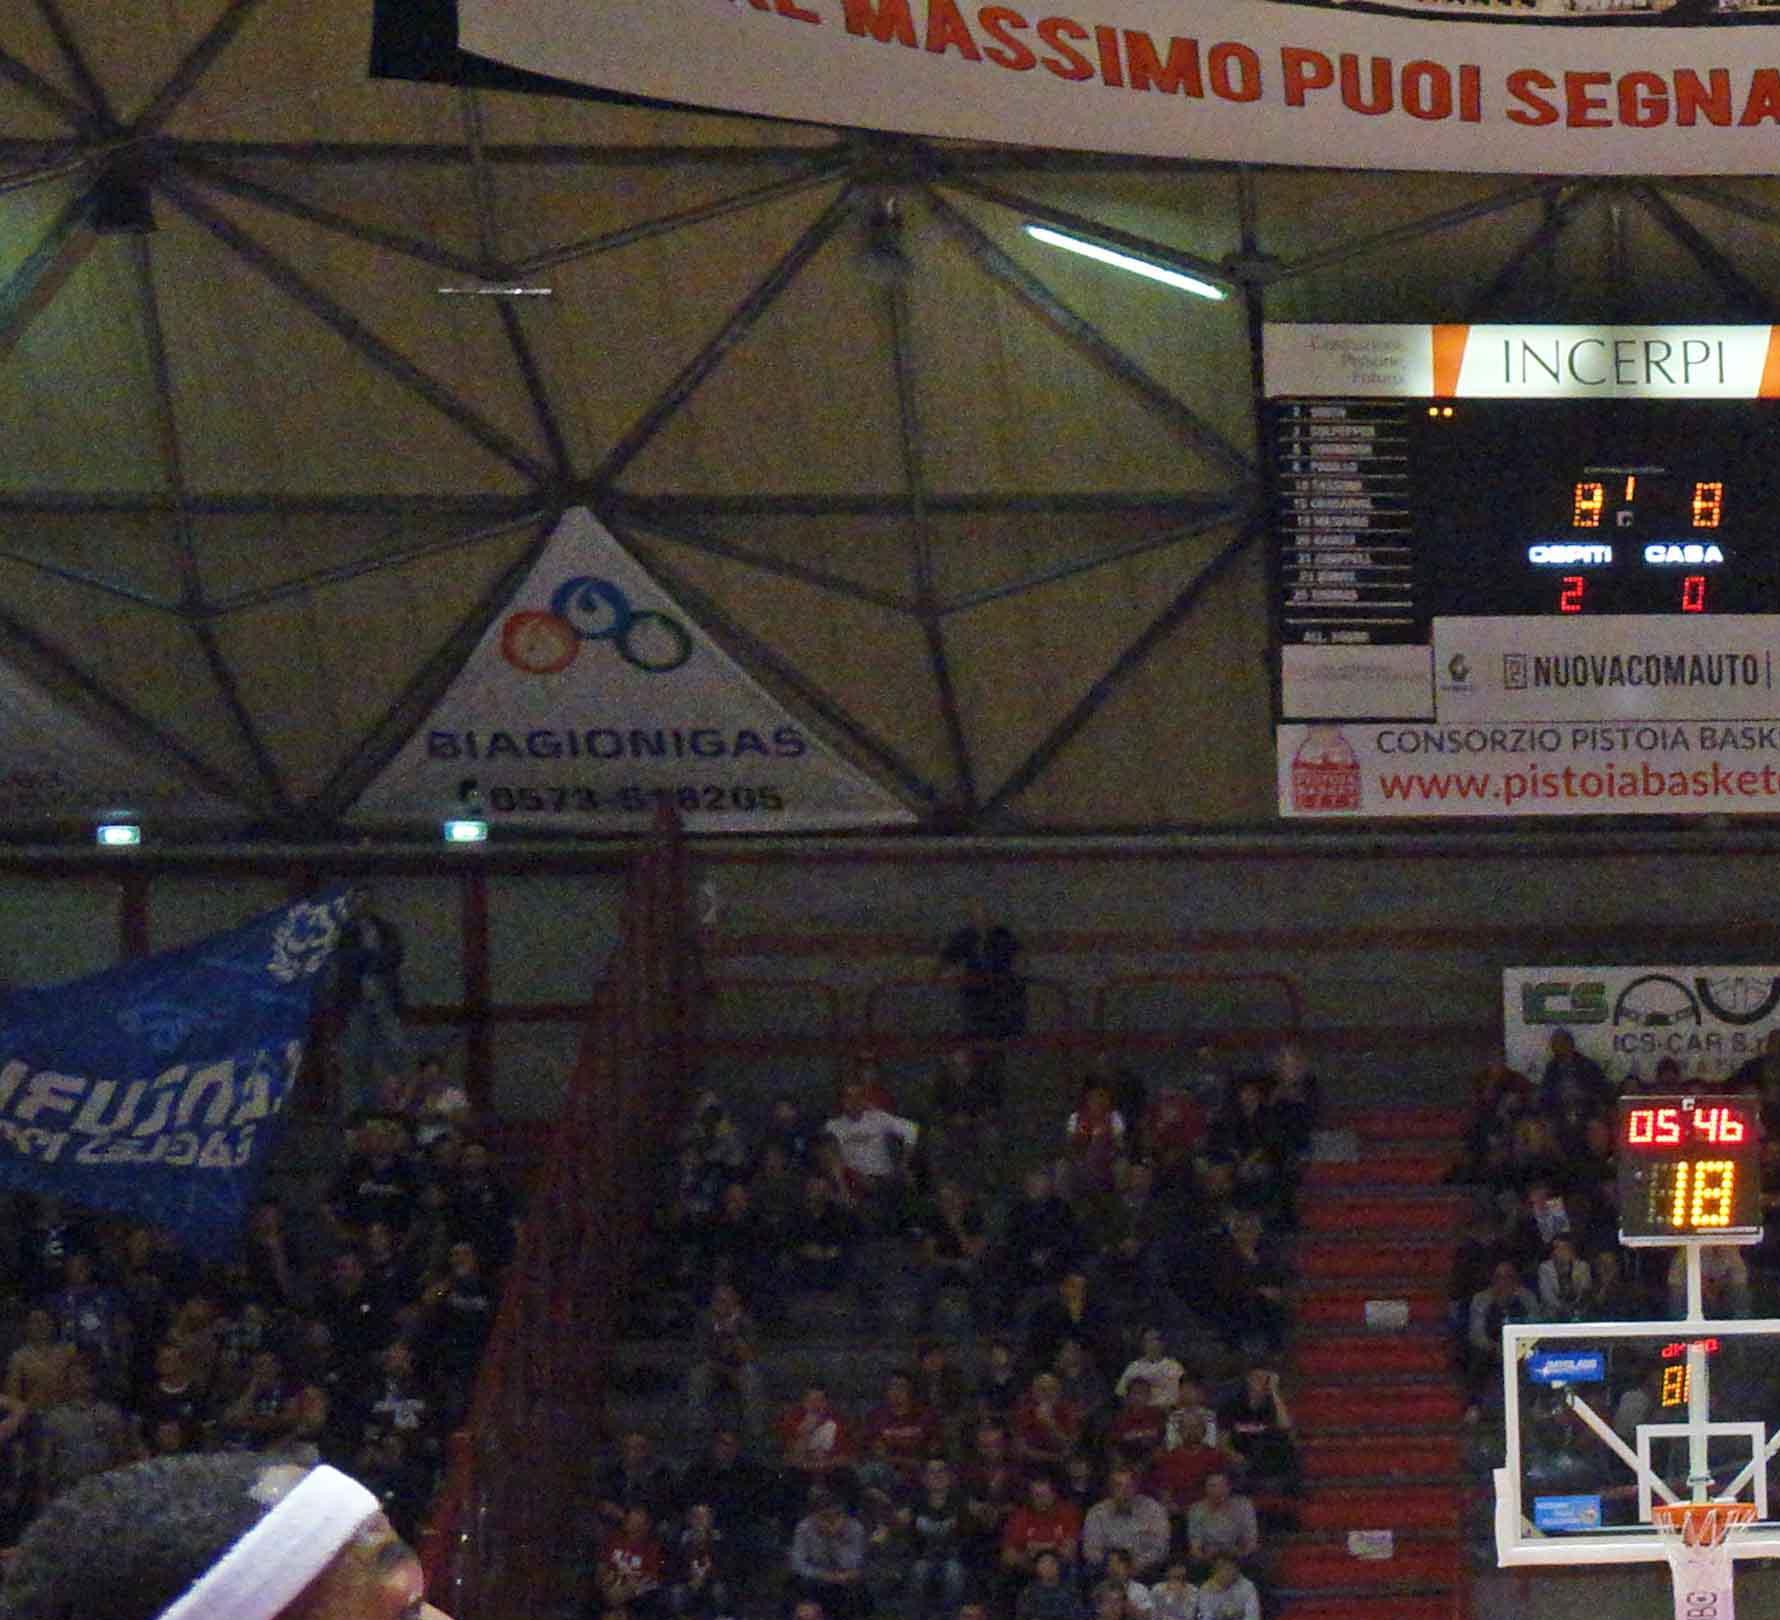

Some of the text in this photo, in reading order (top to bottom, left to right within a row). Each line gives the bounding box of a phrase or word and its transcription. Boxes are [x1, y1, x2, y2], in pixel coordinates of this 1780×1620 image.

[845, 0, 1262, 103] MASSIMO
[1281, 46, 1482, 123] PUOI
[1503, 338, 1725, 386] INCERPI
[1644, 545, 1724, 563] CASA
[1560, 575, 1706, 612] 2 0
[1533, 653, 1759, 690] NUOVACOMAUTO
[427, 729, 807, 760] BIAGIONIGAS
[1377, 729, 1562, 755] CONSORZIO
[1572, 728, 1692, 753] PISTOIA
[1671, 1159, 1735, 1228] 18
